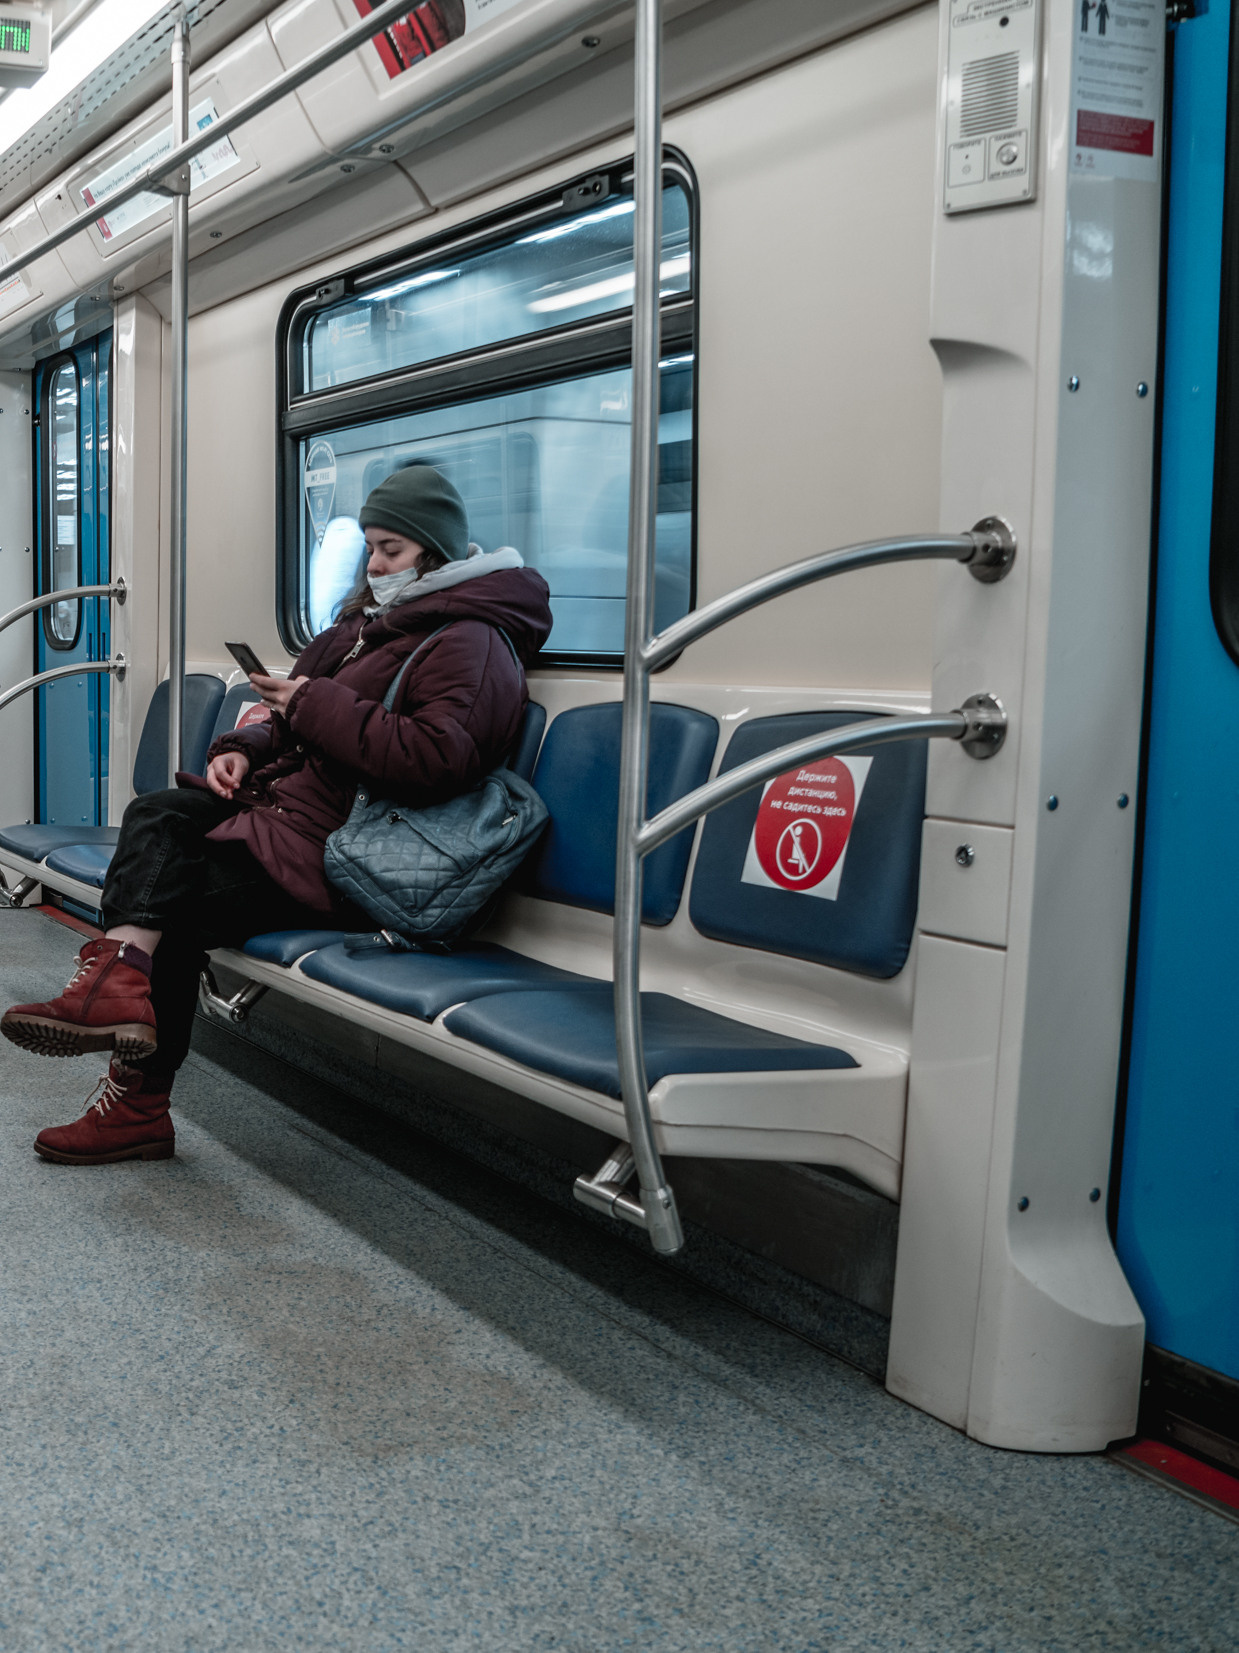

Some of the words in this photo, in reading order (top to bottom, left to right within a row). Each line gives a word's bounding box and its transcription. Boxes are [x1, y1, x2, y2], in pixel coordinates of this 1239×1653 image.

[796, 769, 837, 784] Держите
[787, 786, 838, 801] дистанцию,
[770, 800, 783, 809] не
[783, 801, 822, 814] садитесь
[822, 806, 847, 817] здесь
